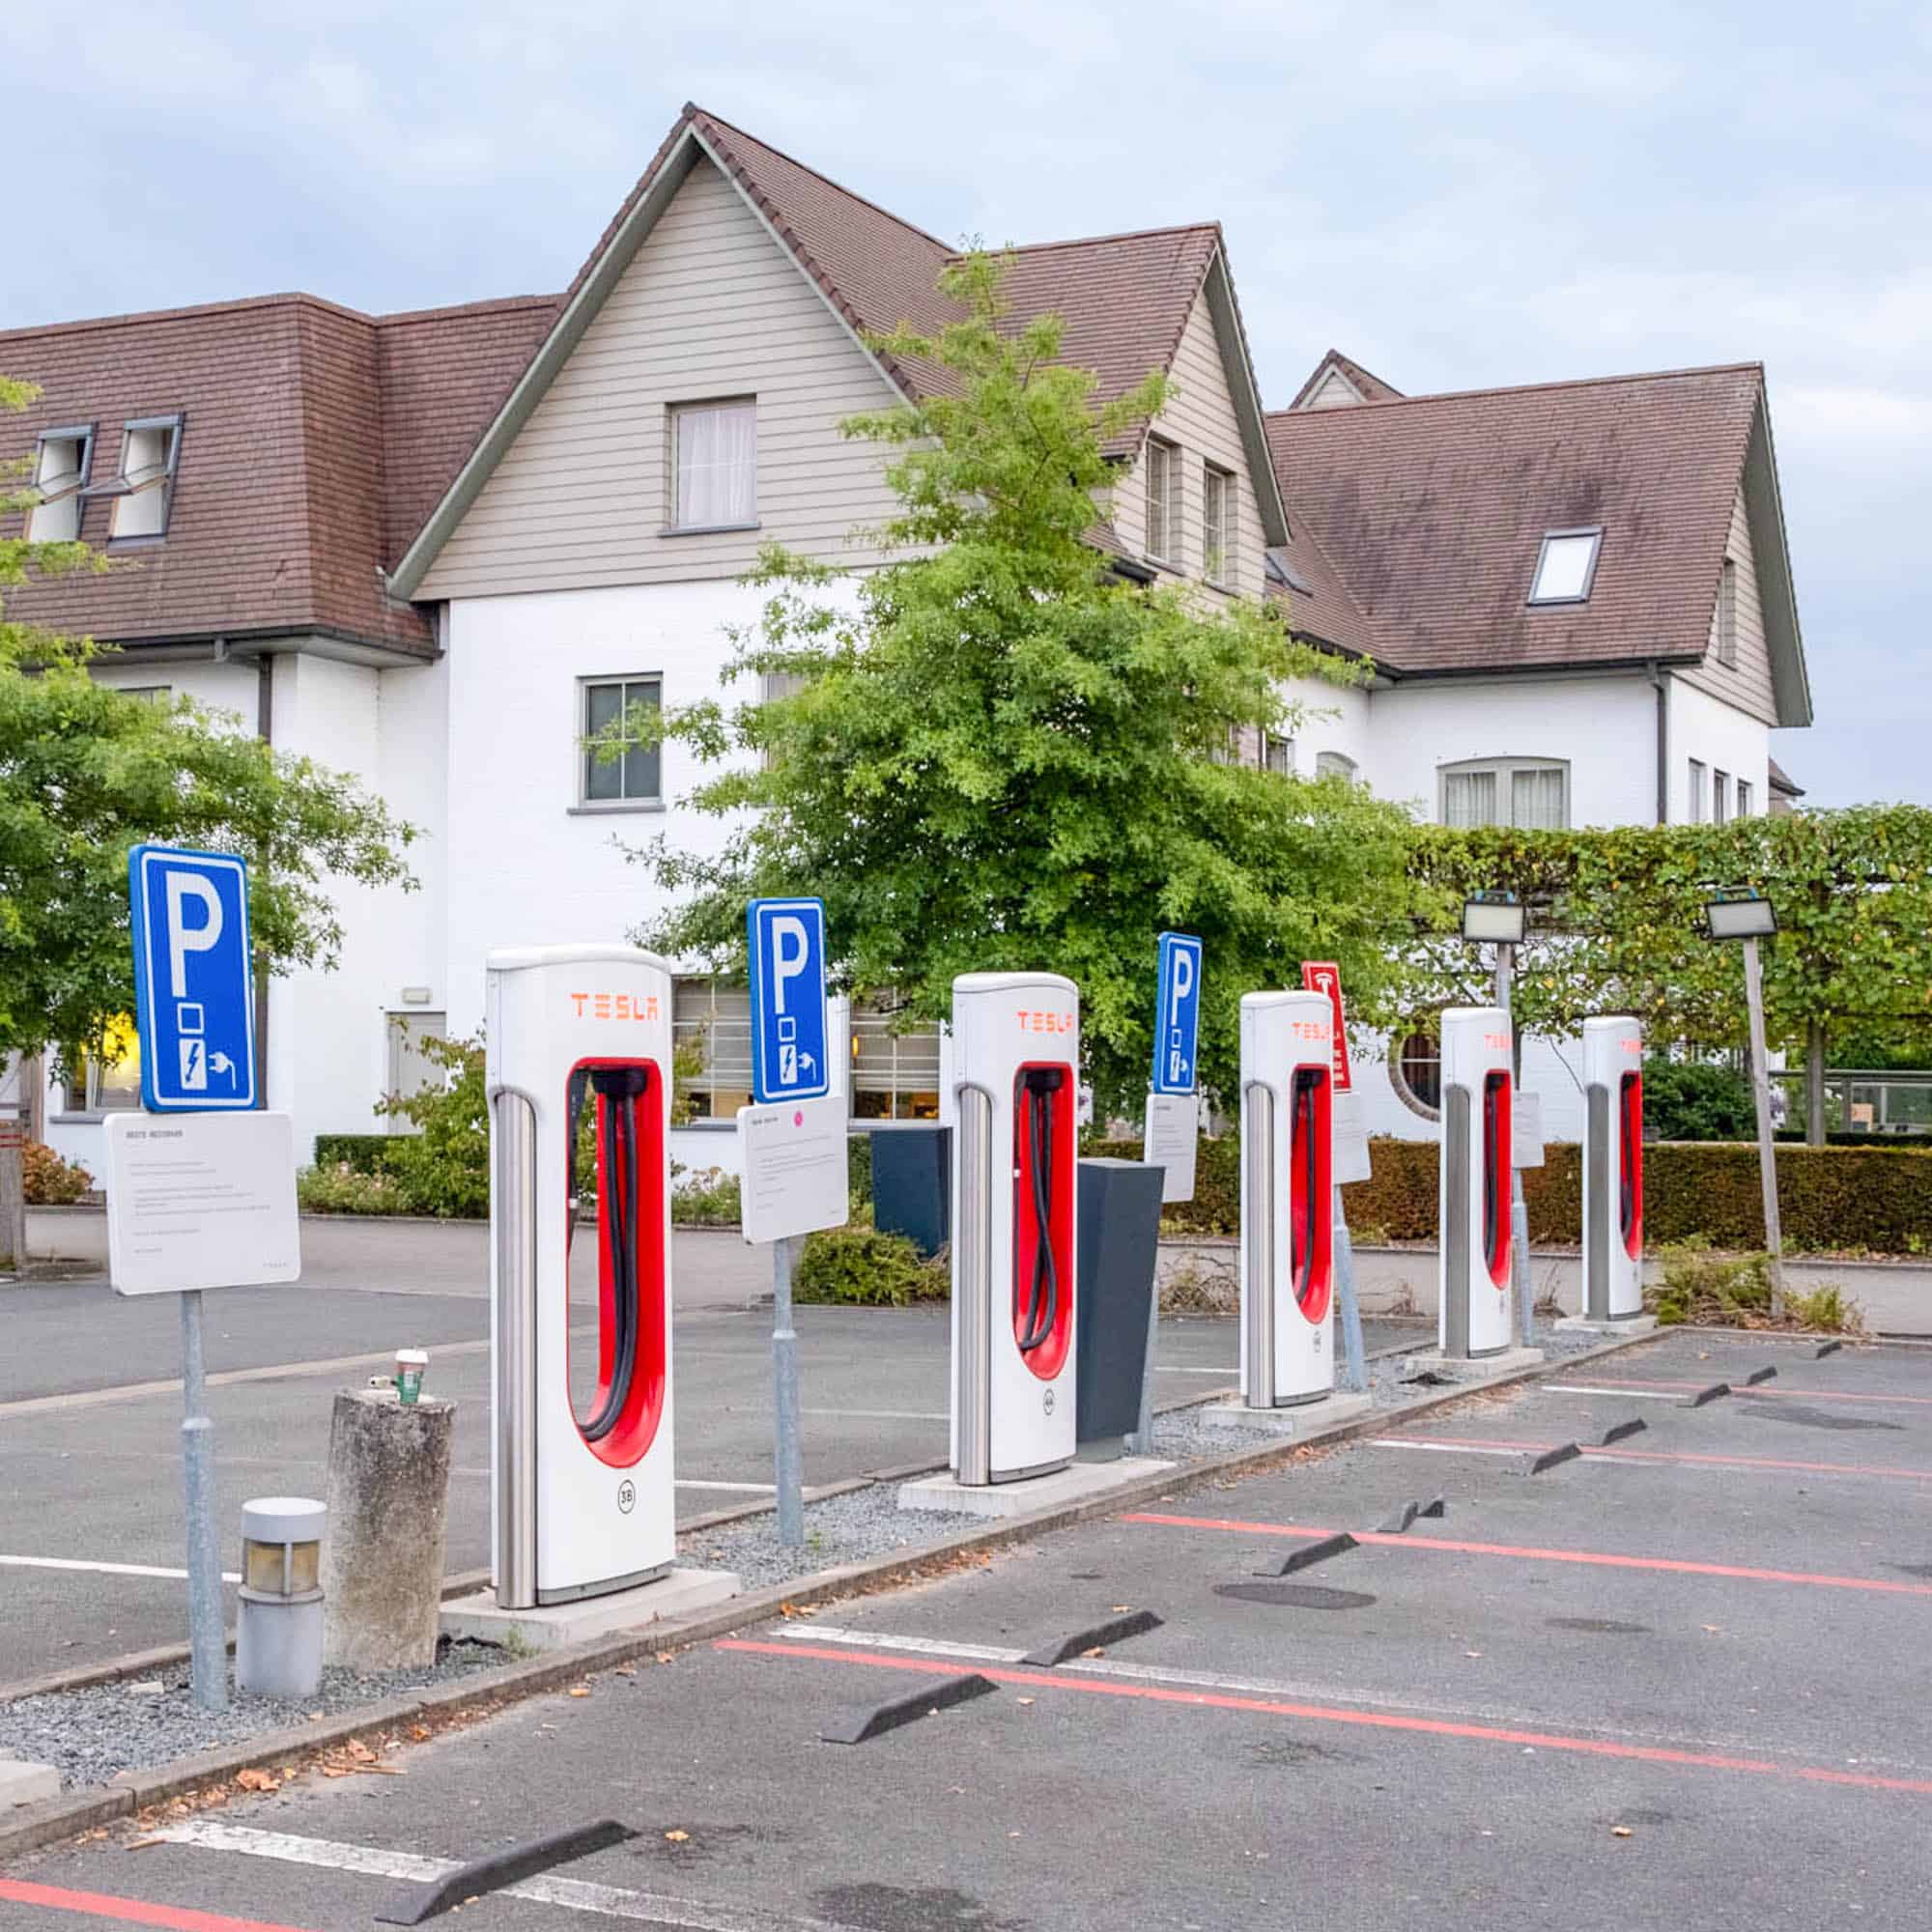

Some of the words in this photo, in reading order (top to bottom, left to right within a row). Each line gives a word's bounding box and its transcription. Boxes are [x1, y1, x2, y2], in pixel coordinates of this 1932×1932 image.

[165, 870, 223, 998] P
[772, 916, 809, 1014] P
[571, 992, 658, 1020] TESLA
[1171, 949, 1193, 1027] P
